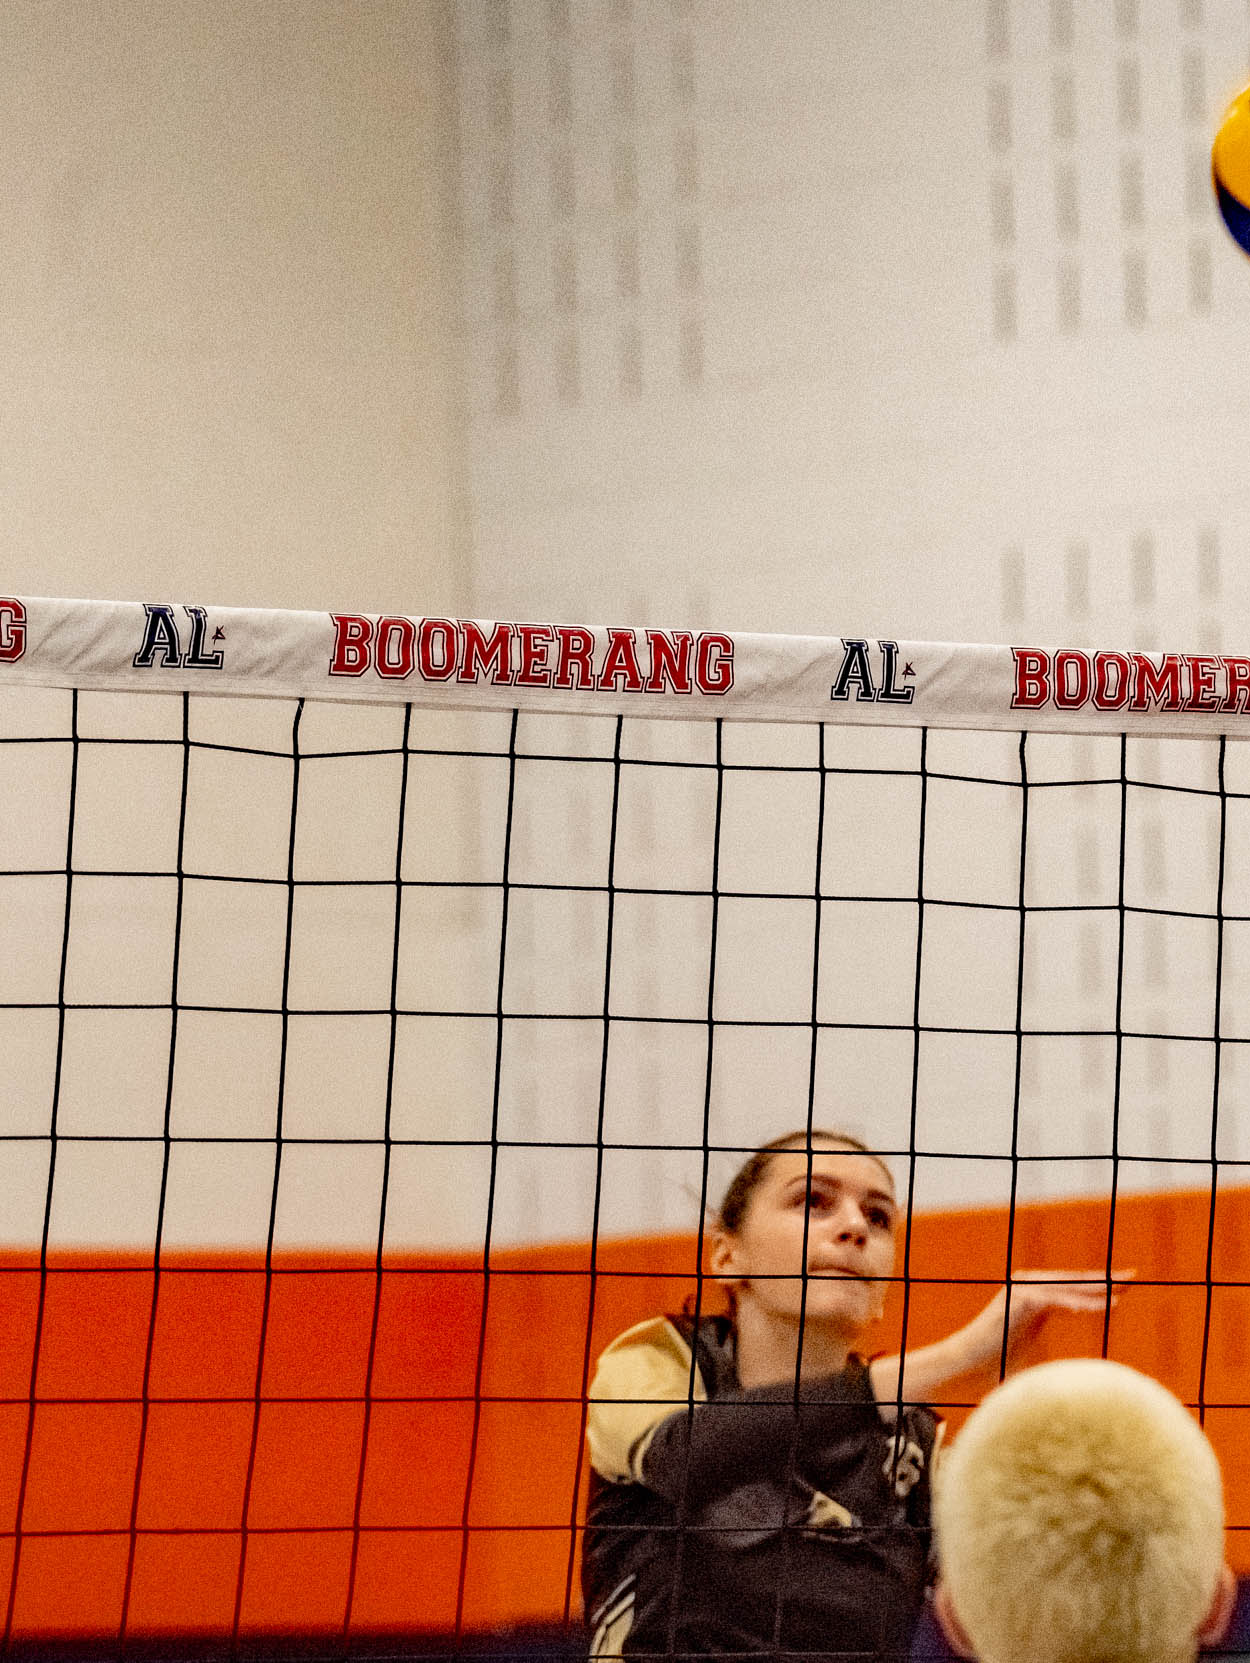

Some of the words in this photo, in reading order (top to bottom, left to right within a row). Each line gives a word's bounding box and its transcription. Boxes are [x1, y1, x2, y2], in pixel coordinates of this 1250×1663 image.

[132, 603, 224, 670] AL
[328, 613, 735, 696] BOOMERANG
[831, 638, 915, 704] AL
